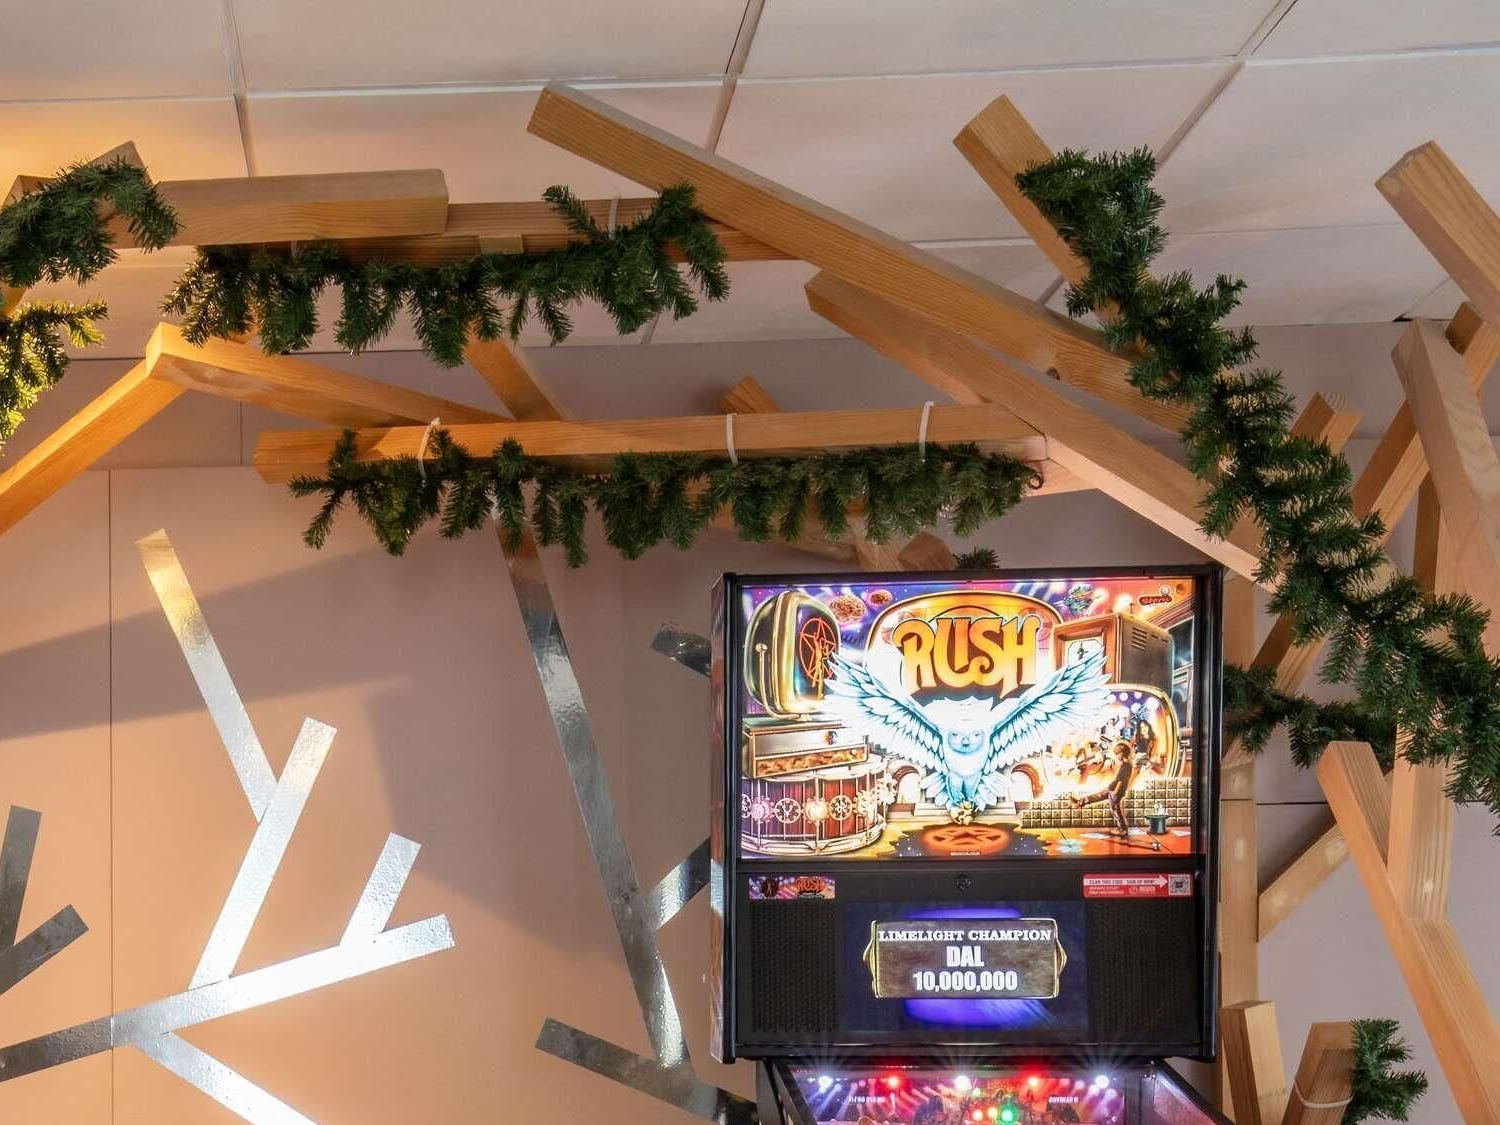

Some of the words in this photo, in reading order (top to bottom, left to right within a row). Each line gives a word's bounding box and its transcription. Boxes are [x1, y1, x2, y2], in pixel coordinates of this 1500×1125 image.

[892, 614, 1042, 698] RUSH
[796, 877, 827, 892] RUSH
[879, 930, 965, 942] LIMELIGHT
[968, 929, 1052, 941] CHAMPION
[946, 945, 985, 967] DAL
[913, 971, 1018, 992] 10,000,000
